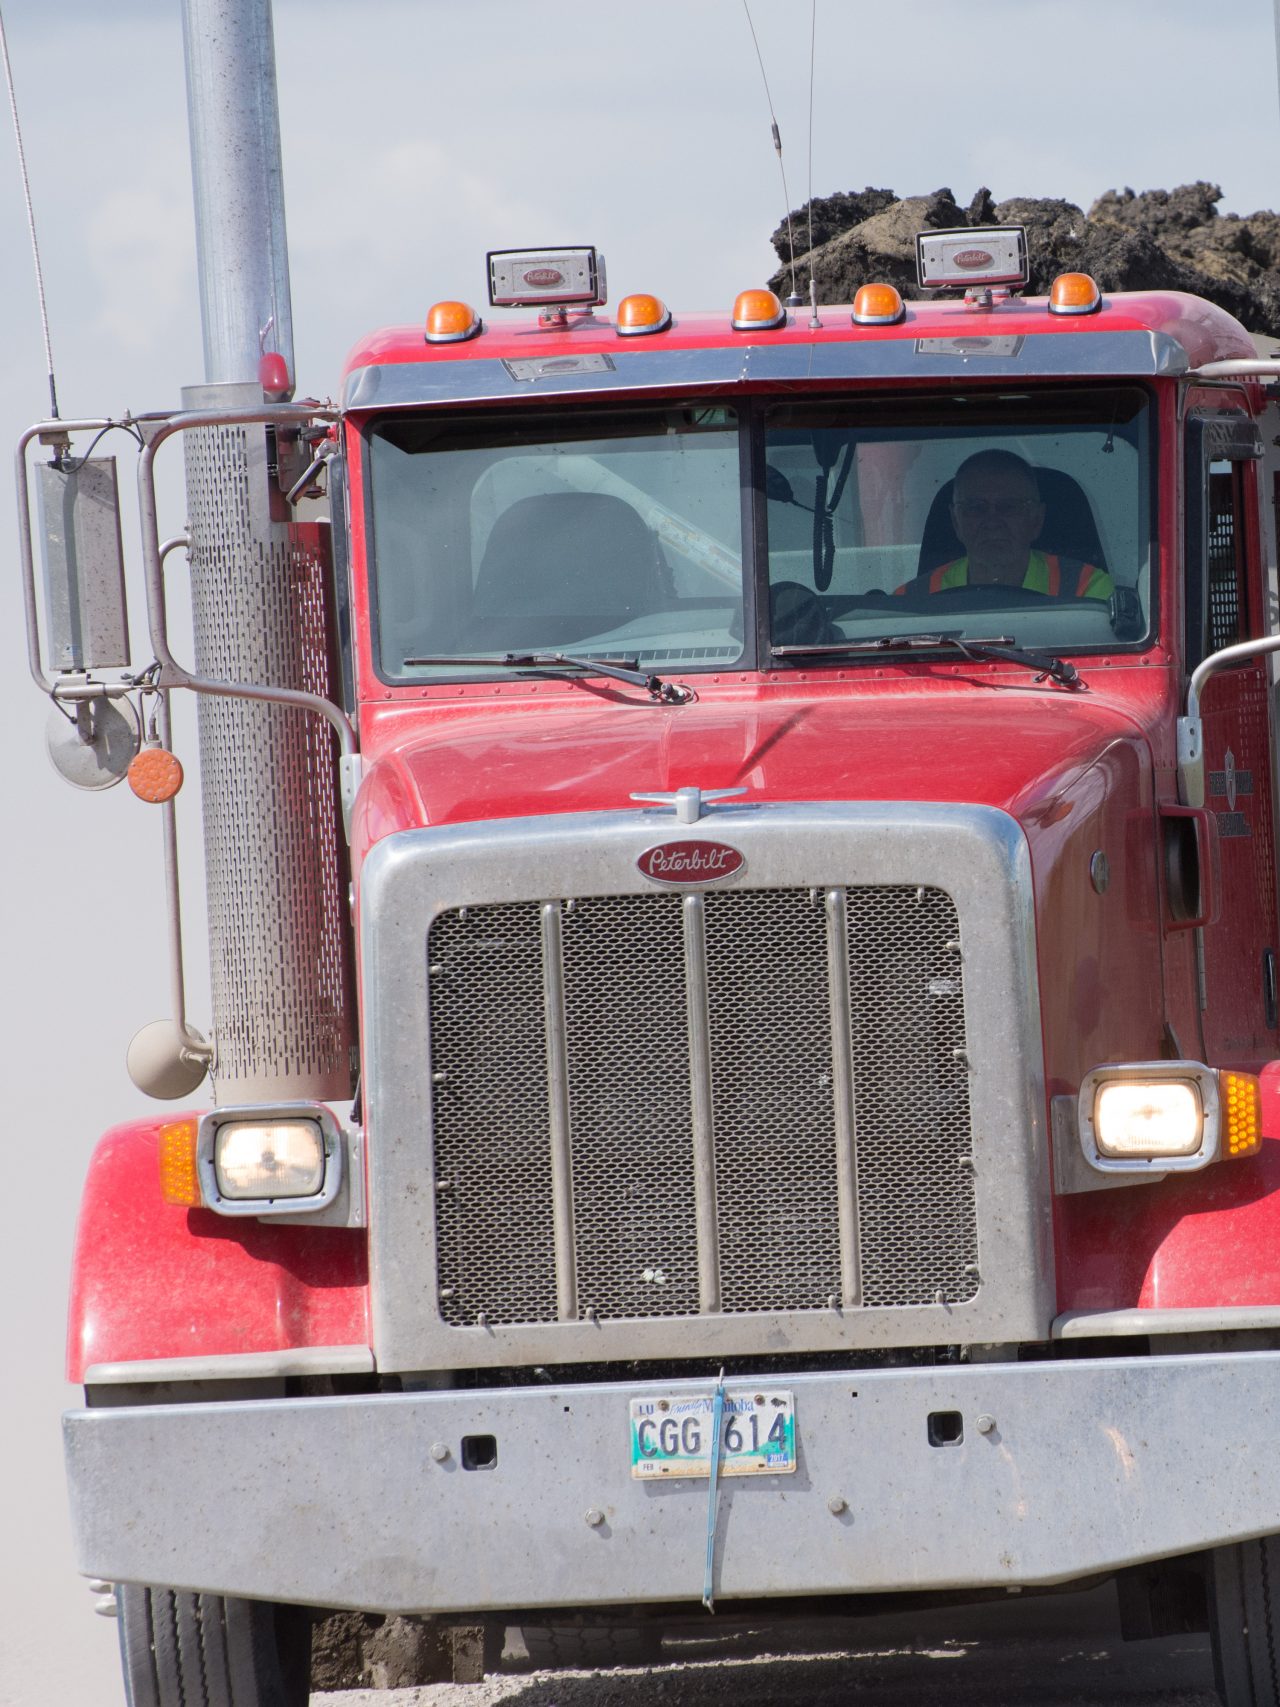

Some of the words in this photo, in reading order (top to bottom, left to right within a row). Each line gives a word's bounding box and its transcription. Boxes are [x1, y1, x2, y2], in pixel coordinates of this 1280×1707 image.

[648, 849, 733, 875] Peterbilt
[639, 1404, 654, 1416] LU
[702, 1398, 754, 1413] Mnitoba
[638, 1416, 700, 1457] CGG
[724, 1412, 786, 1452] 614
[643, 1463, 654, 1471] FEB
